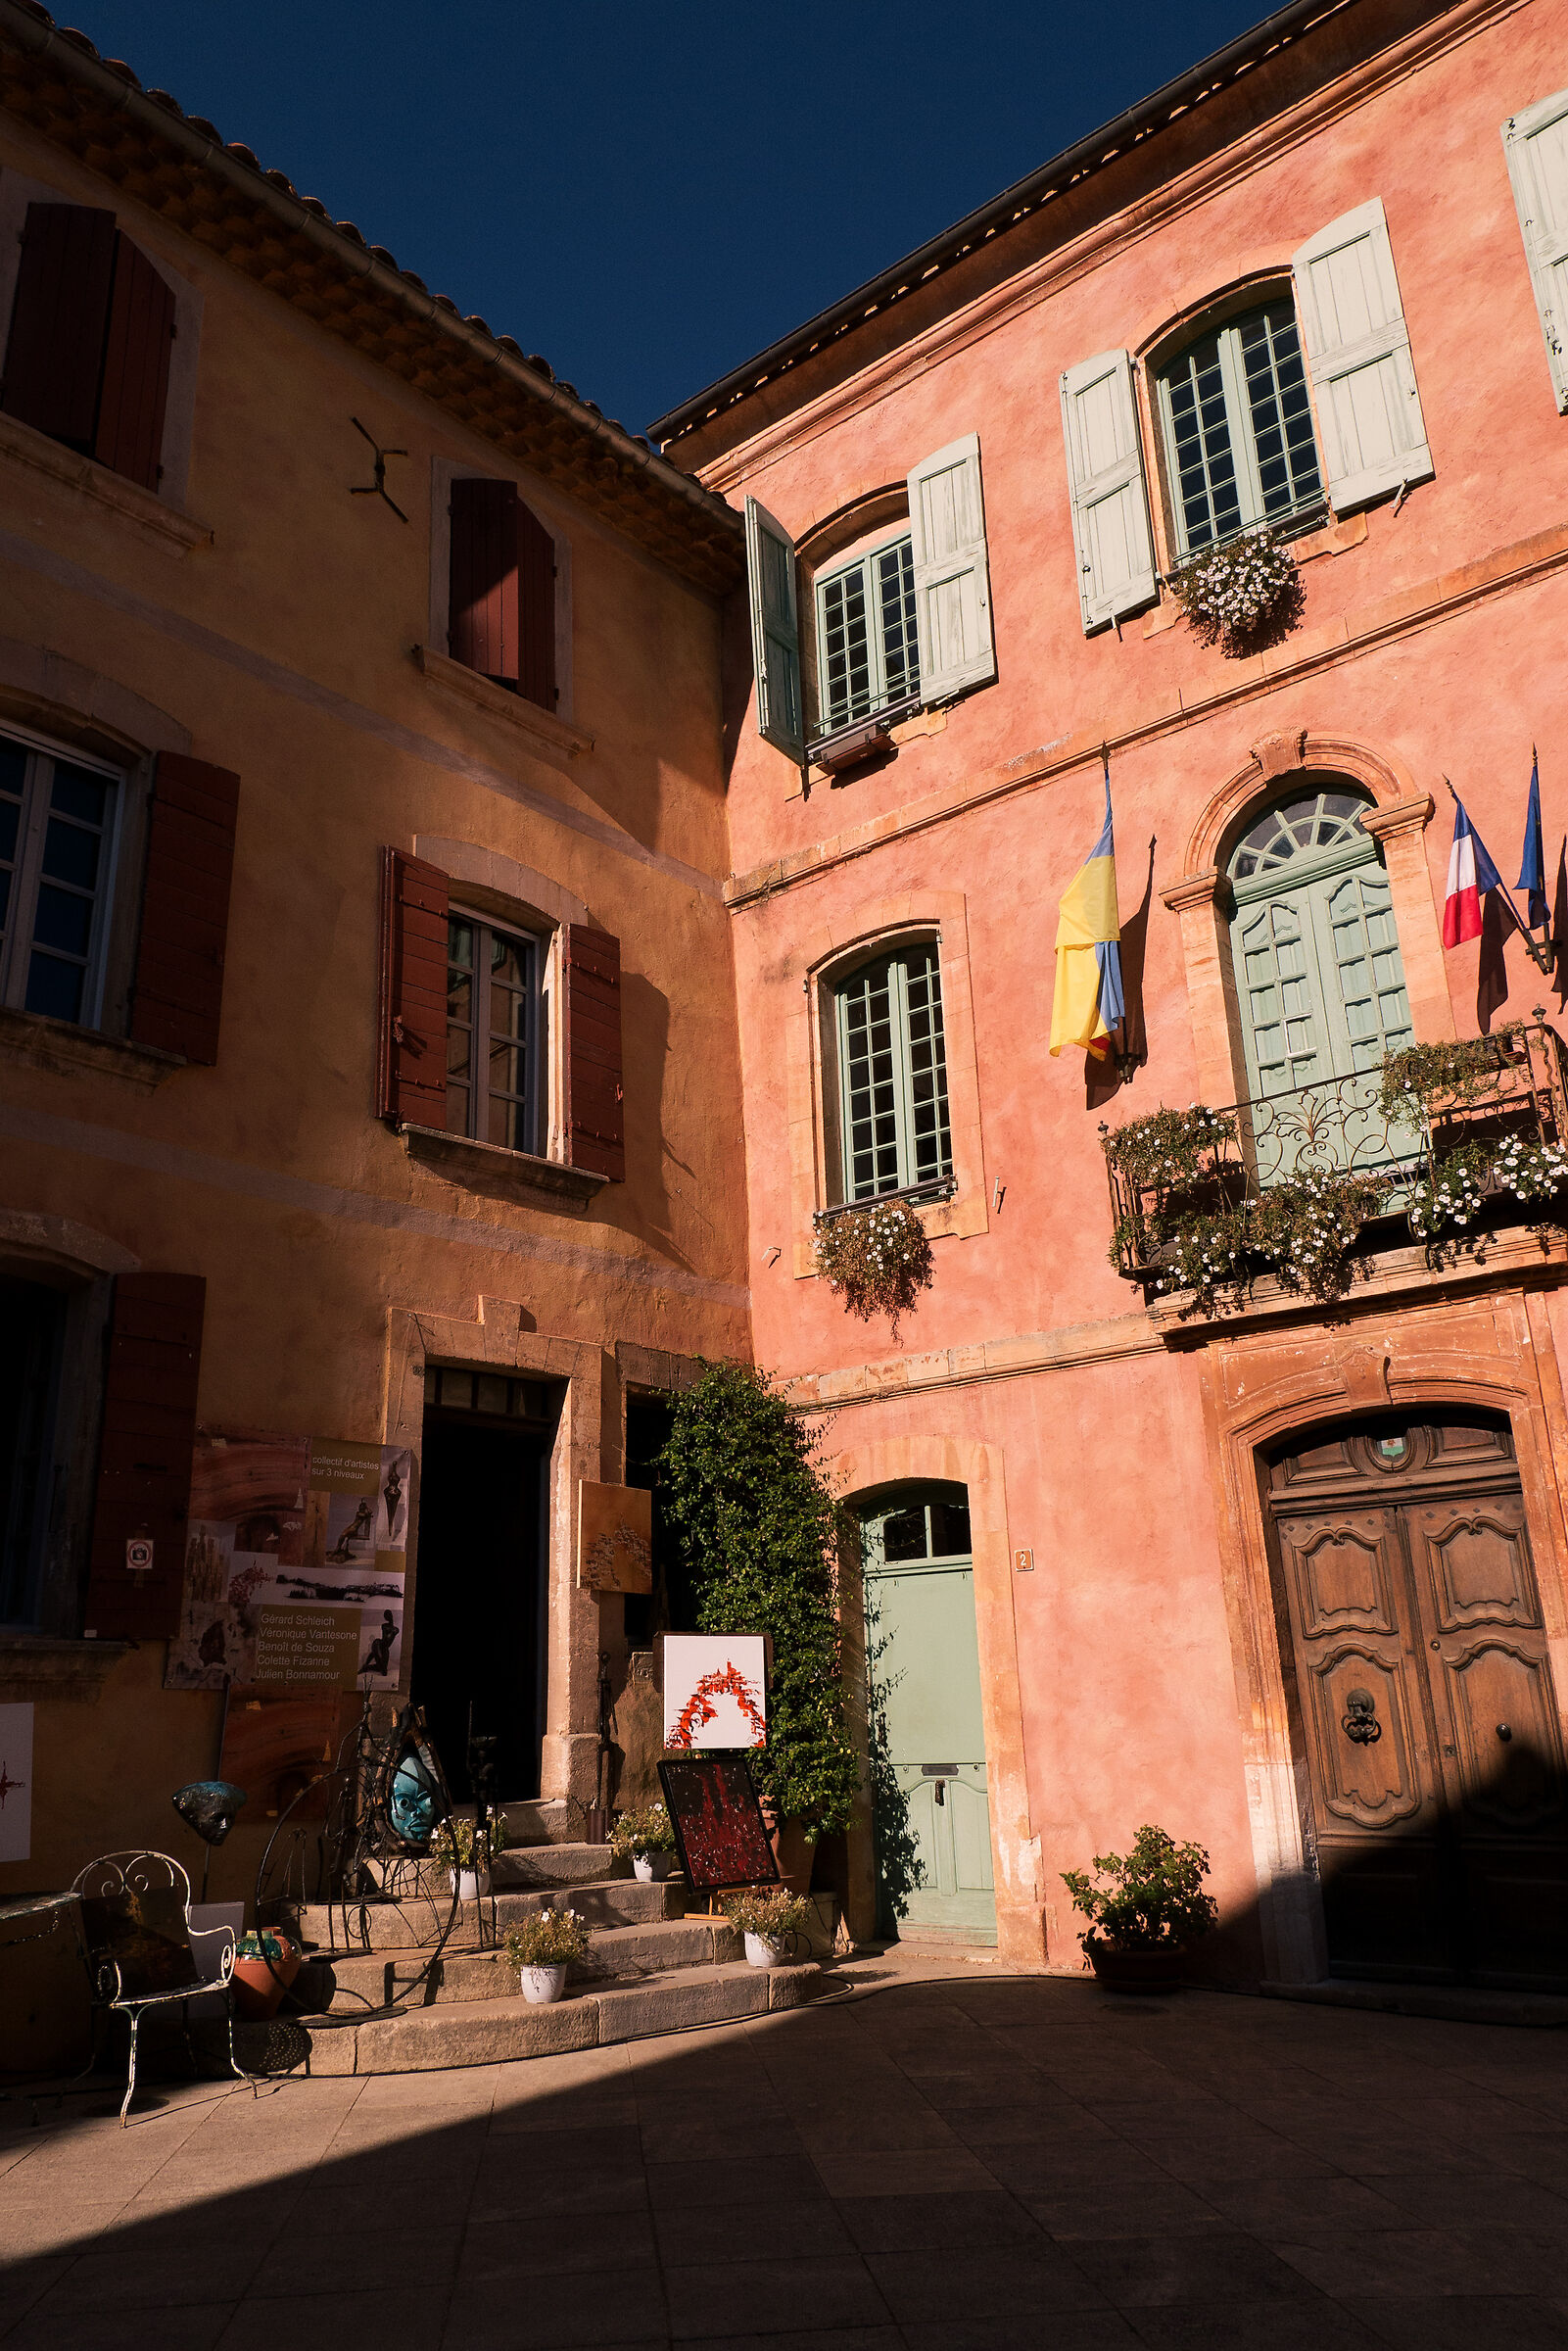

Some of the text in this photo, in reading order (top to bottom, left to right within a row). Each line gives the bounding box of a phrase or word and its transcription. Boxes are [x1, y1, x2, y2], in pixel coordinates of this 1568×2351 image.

[312, 1456, 379, 1469] collectif d'artistes
[327, 1467, 332, 1476] 3
[335, 1469, 364, 1479] niveaux
[1020, 1554, 1026, 1565] 2
[261, 1614, 334, 1626] Gérard Schleich
[260, 1627, 356, 1640] Véronique Vantesone
[259, 1641, 334, 1652] Benoît de Souza
[258, 1655, 329, 1665] Colette Fizanne
[257, 1669, 340, 1679] Julien Bonnamour
